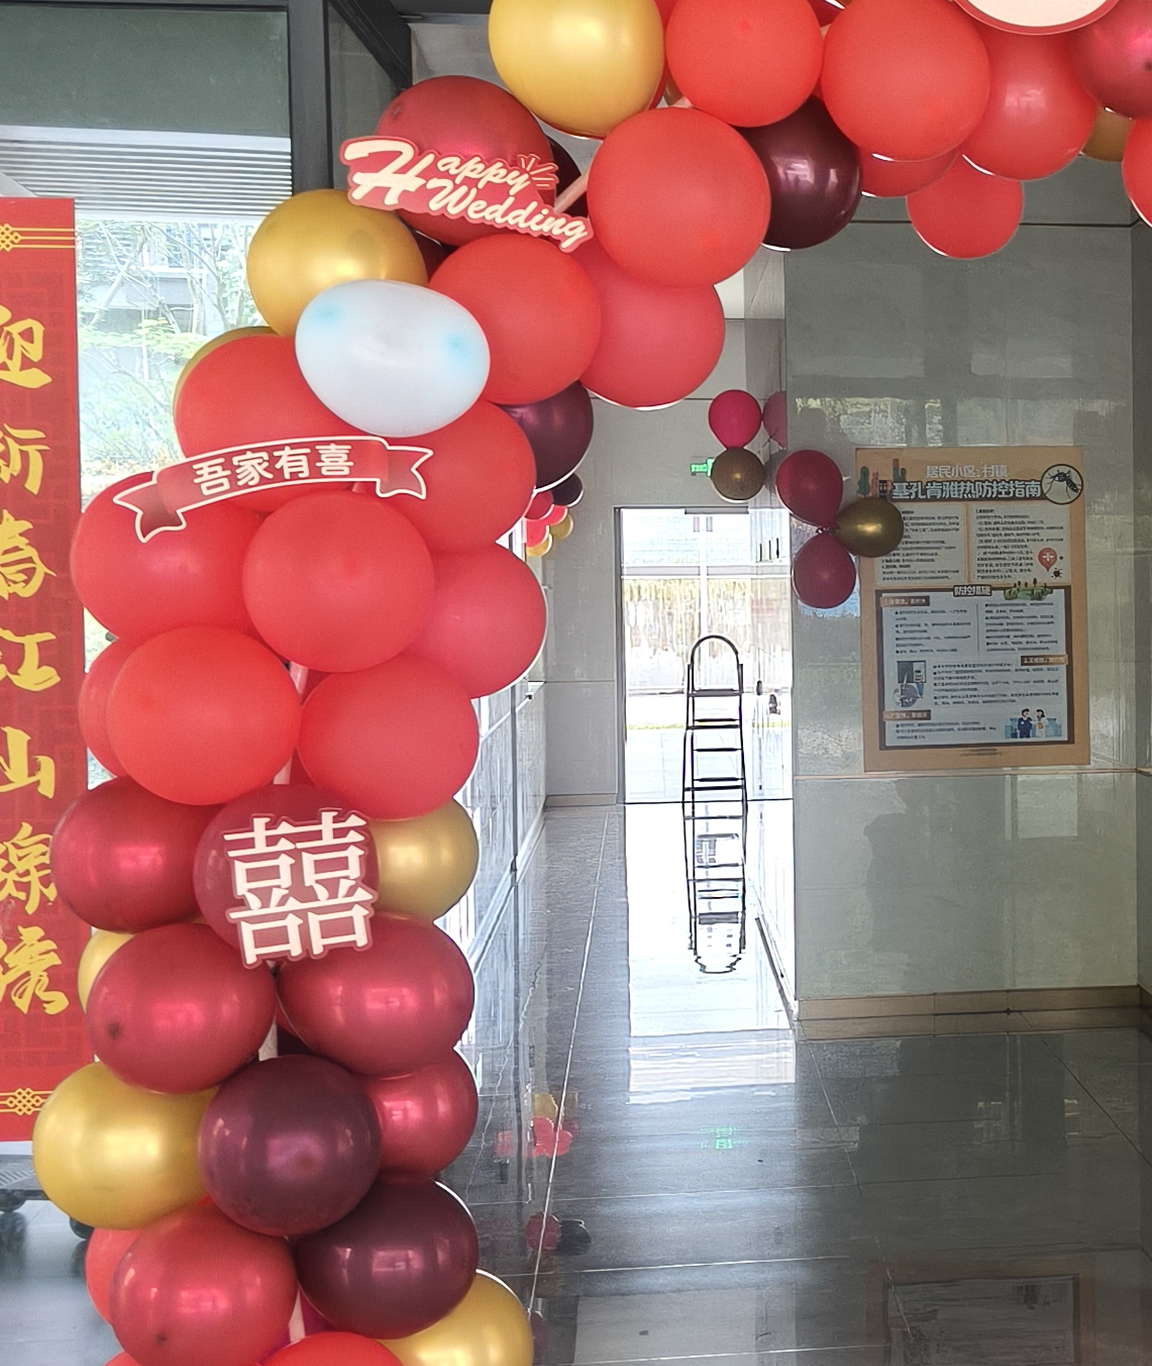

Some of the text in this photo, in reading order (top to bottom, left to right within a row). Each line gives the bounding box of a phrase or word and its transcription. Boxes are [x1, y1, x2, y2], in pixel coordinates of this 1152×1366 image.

[344, 140, 531, 205] Happy
[426, 178, 588, 249] Wedding
[192, 443, 354, 496] 吾家有喜
[892, 480, 1041, 499] 基孔肯雅热防控指南
[223, 811, 373, 965] 囍
